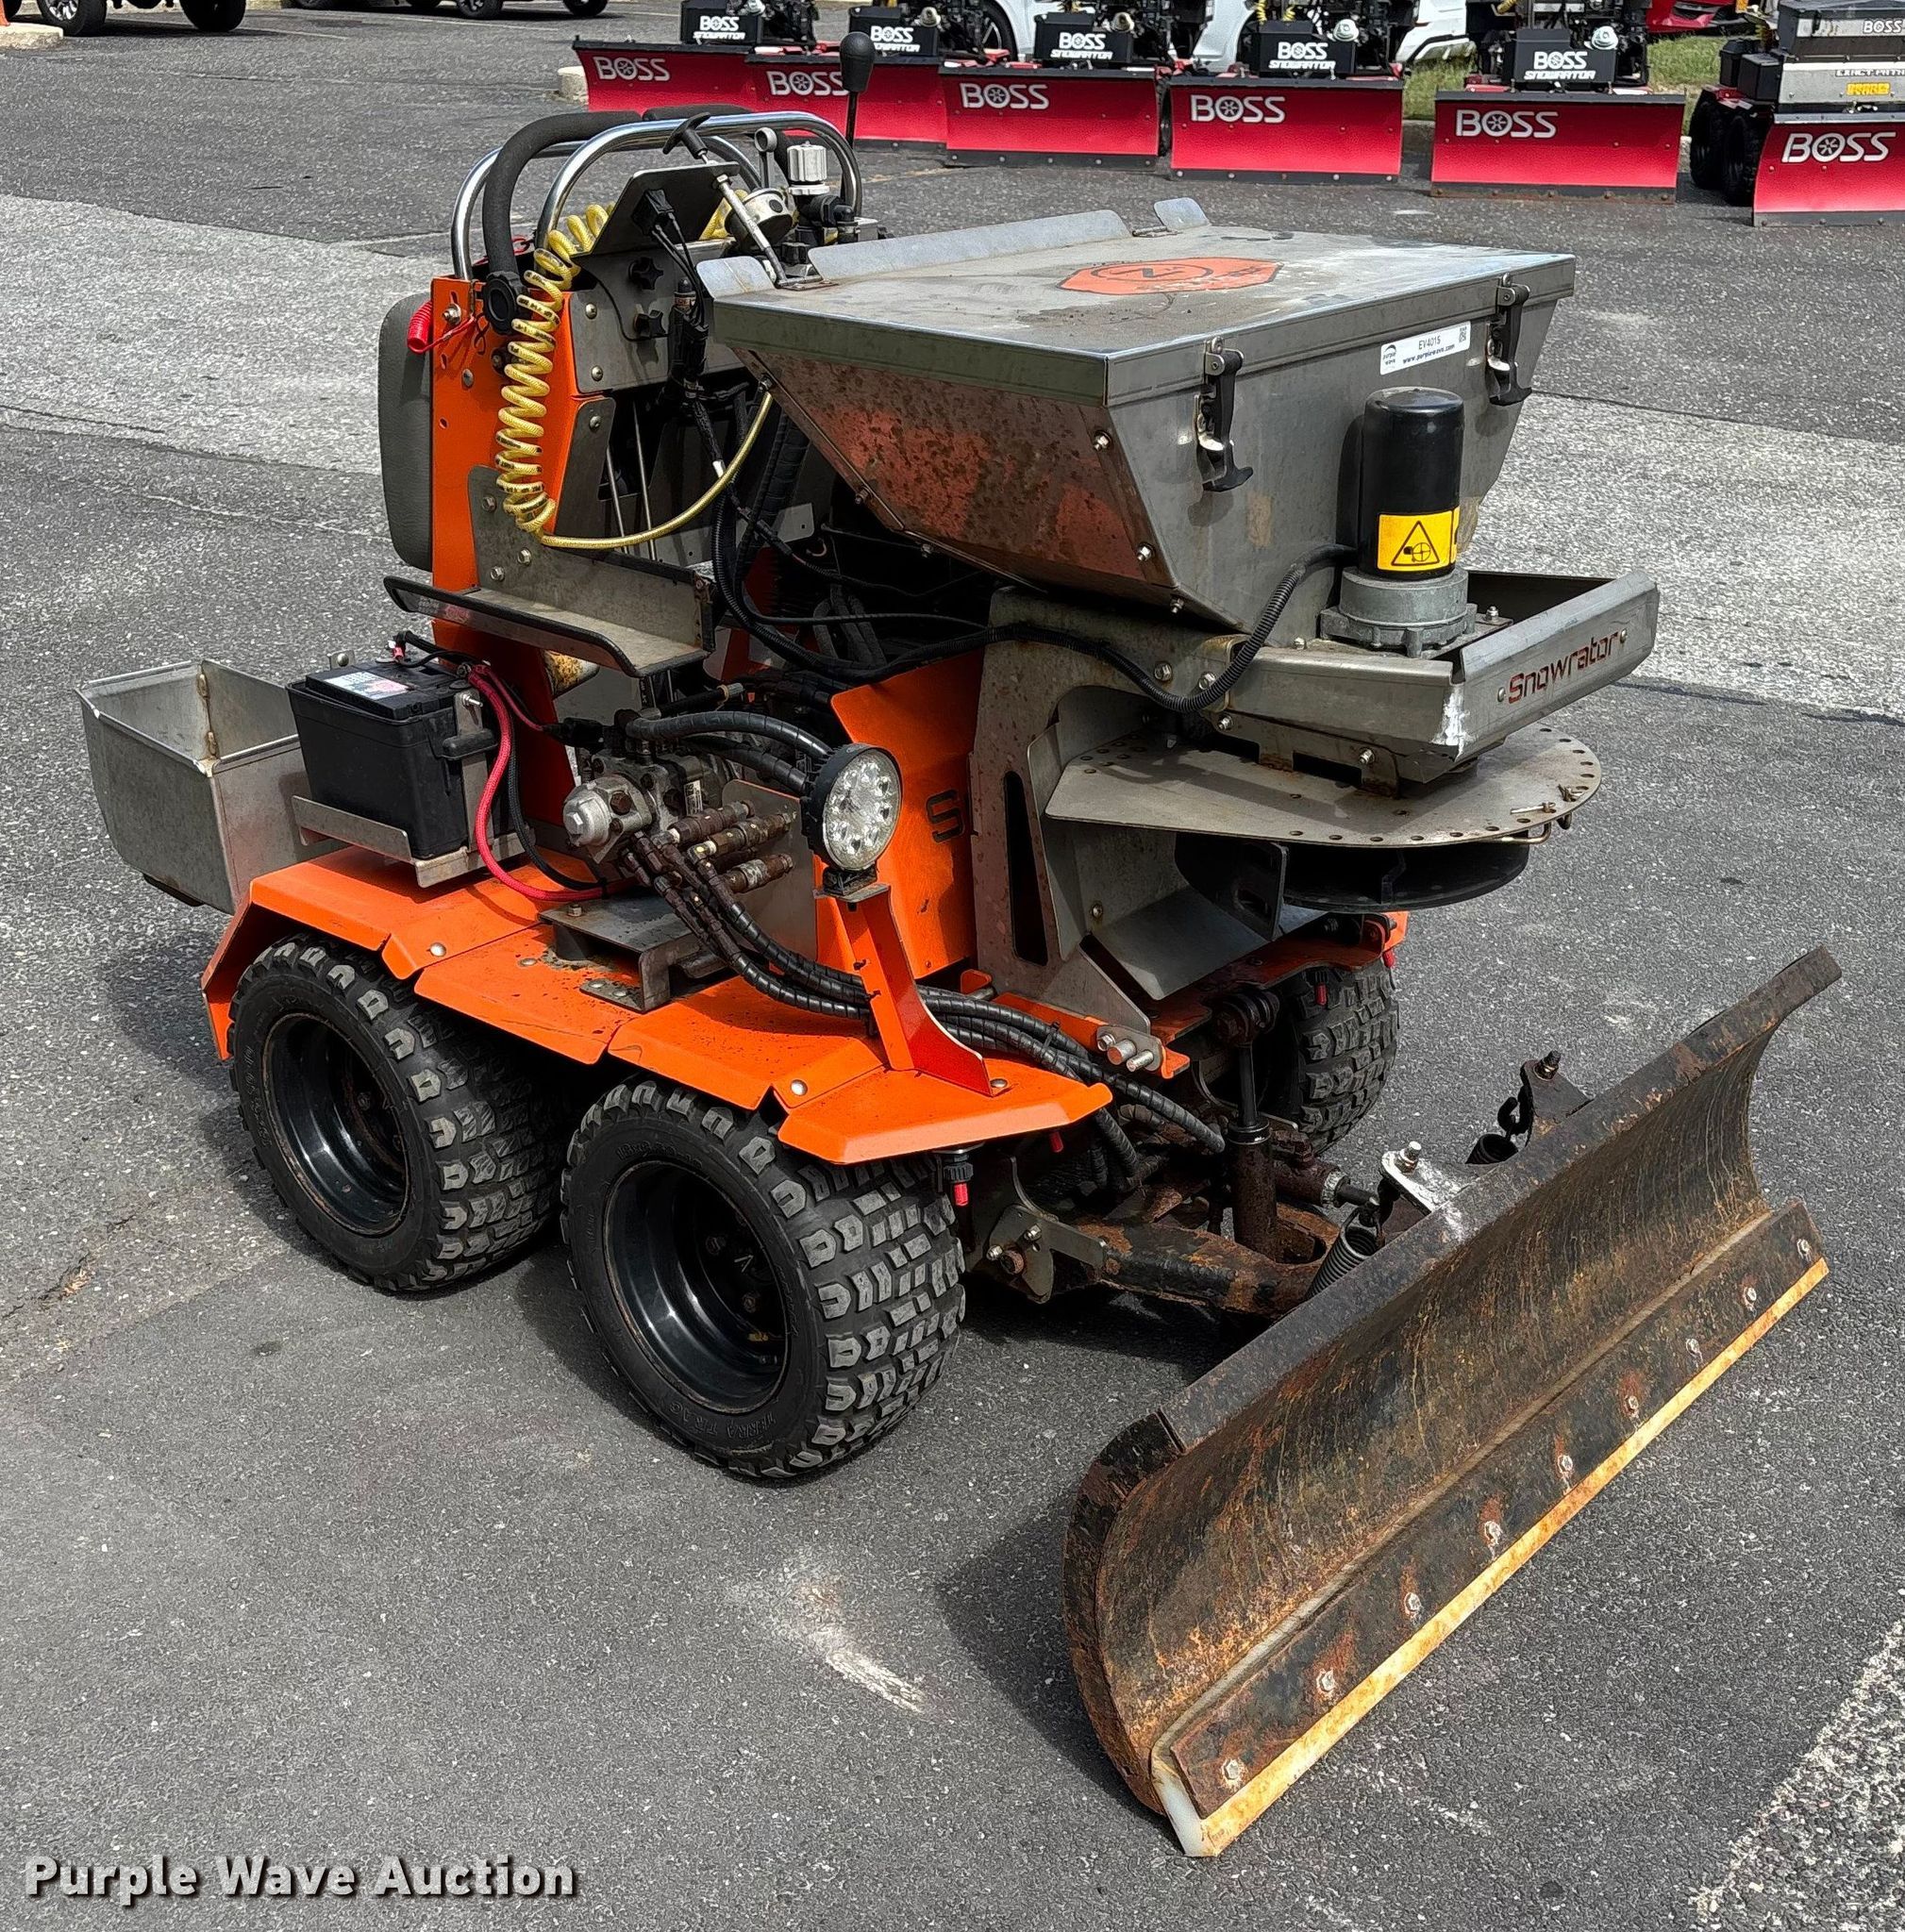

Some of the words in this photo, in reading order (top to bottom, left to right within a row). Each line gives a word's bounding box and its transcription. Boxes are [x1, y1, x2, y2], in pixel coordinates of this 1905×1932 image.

[699, 15, 740, 31] BOSS
[1863, 20, 1904, 34] BOSS
[870, 25, 914, 43] BOSS
[1059, 32, 1106, 50] BOSS
[874, 42, 921, 53] OWRATOR
[1050, 49, 1113, 59] SNOWRATOR
[1278, 42, 1328, 59] BOSS
[593, 56, 670, 81] BOSS
[1268, 59, 1336, 70] SNOWRATOR
[1533, 51, 1587, 70] BOSS
[765, 71, 849, 95] BOSS
[1523, 70, 1596, 80] SNOWRATOR
[960, 83, 1049, 109] BOSS
[1191, 94, 1286, 124] BOSS
[1456, 109, 1559, 138] BOSS
[1781, 131, 1897, 162] BOSS
[1418, 335, 1442, 351] EV4015
[1508, 631, 1618, 704] Snowrator
